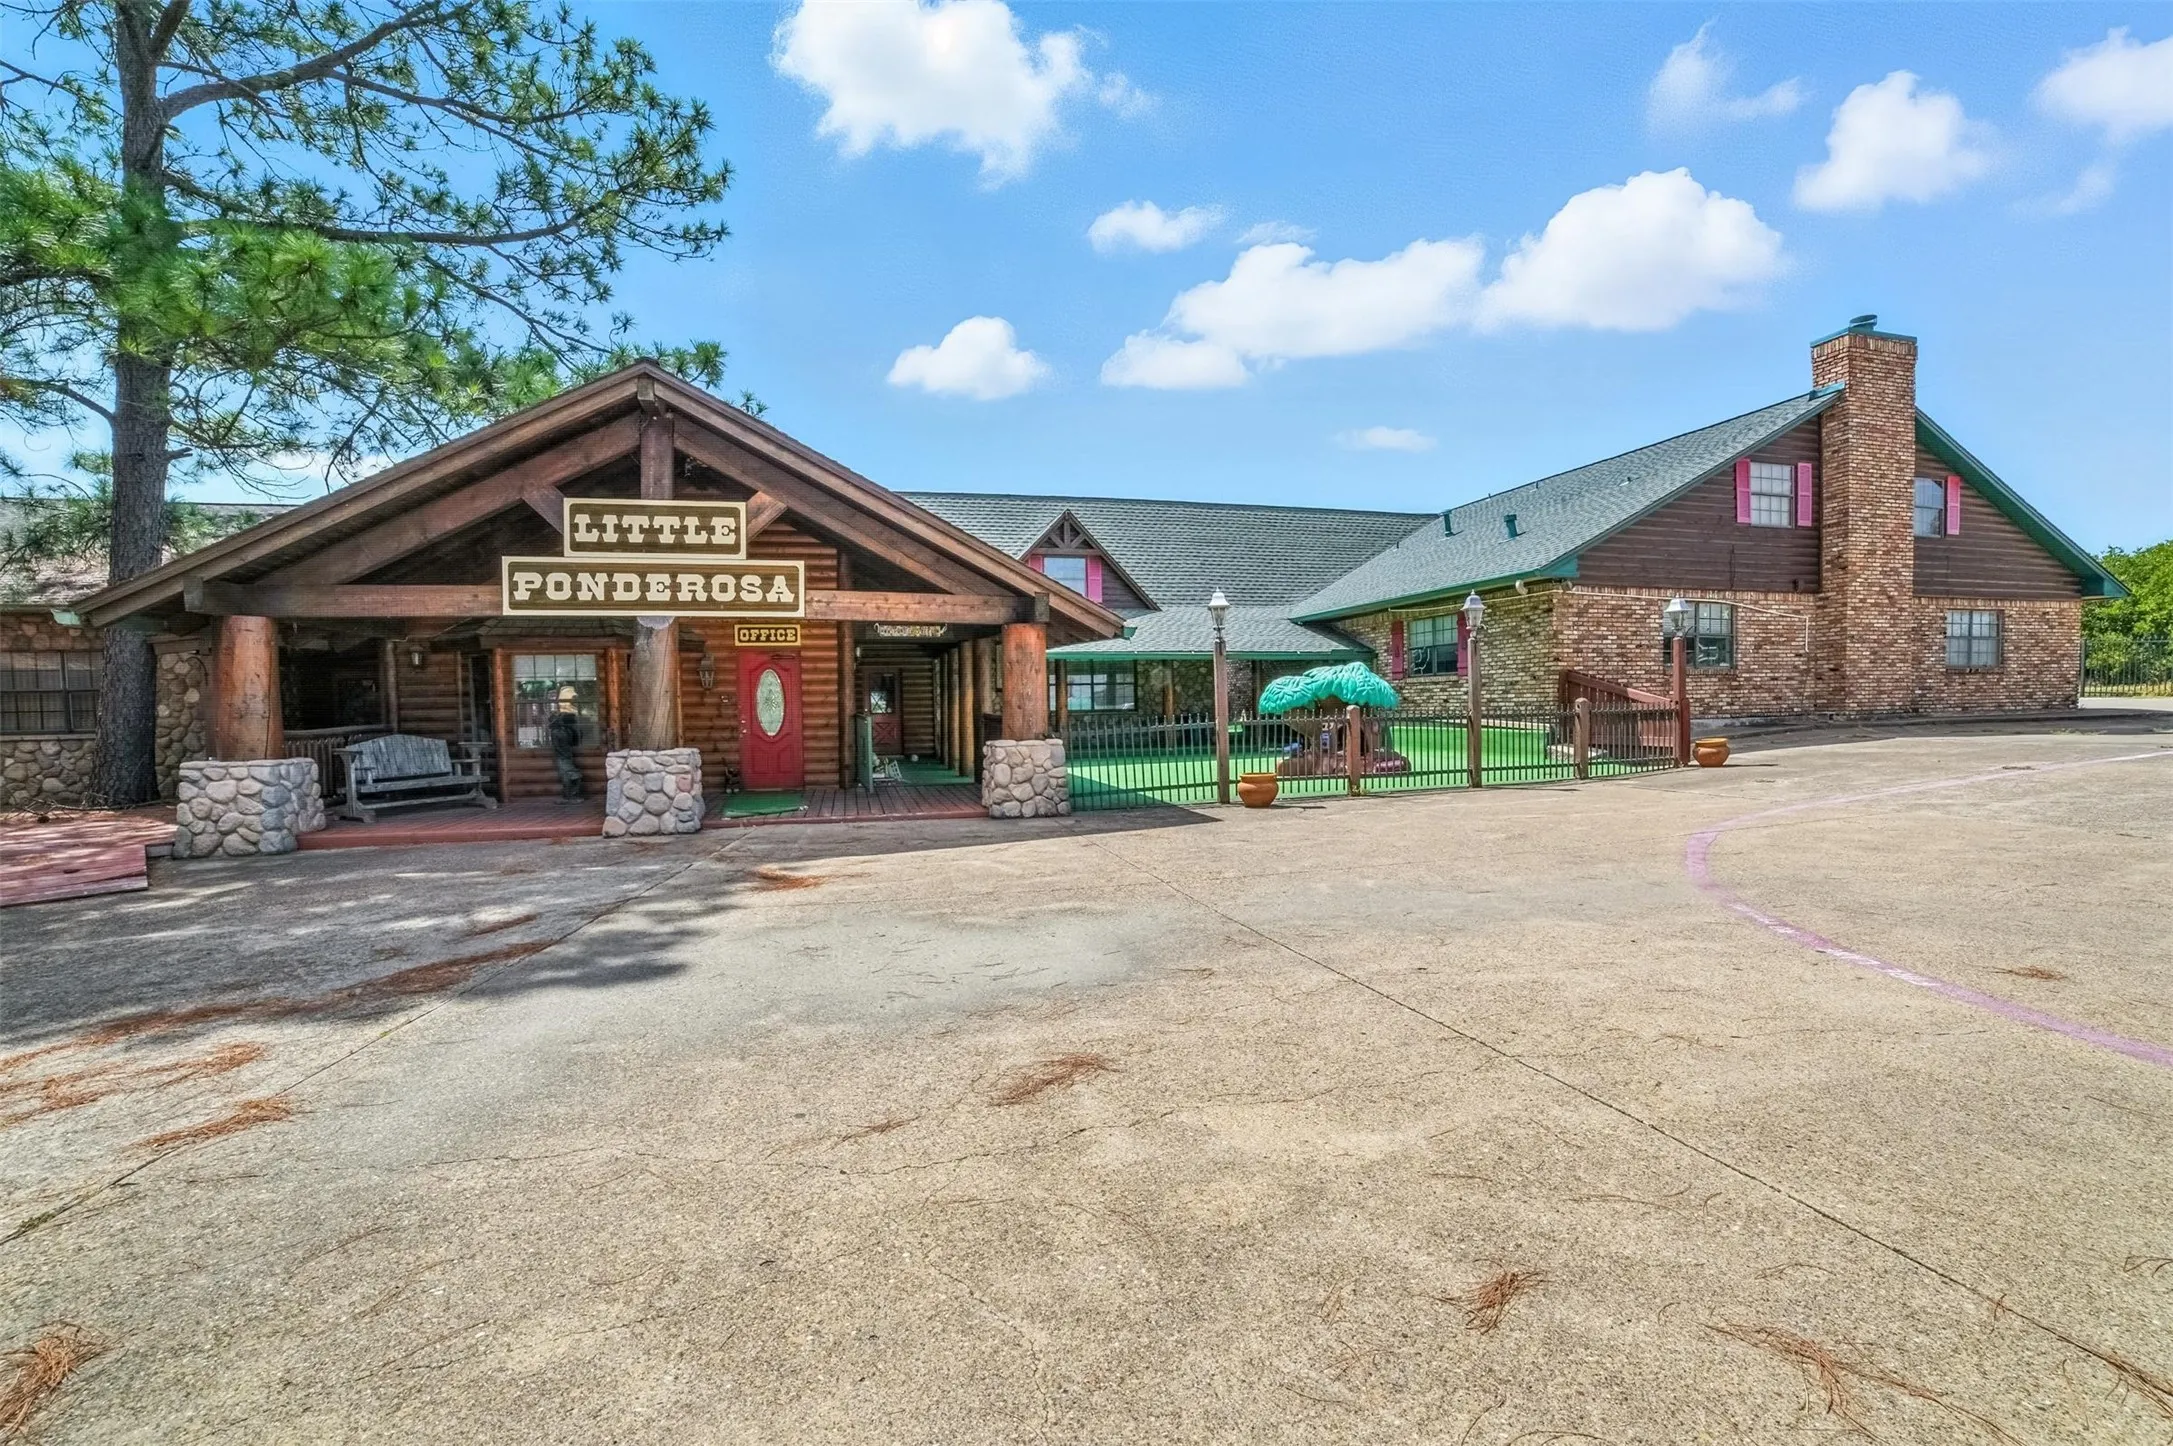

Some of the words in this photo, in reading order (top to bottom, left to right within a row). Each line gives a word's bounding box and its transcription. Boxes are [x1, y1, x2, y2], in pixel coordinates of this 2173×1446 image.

[573, 514, 737, 545] LITTLE
[512, 572, 796, 603] PONDEROSA
[739, 628, 797, 642] OFFICE
